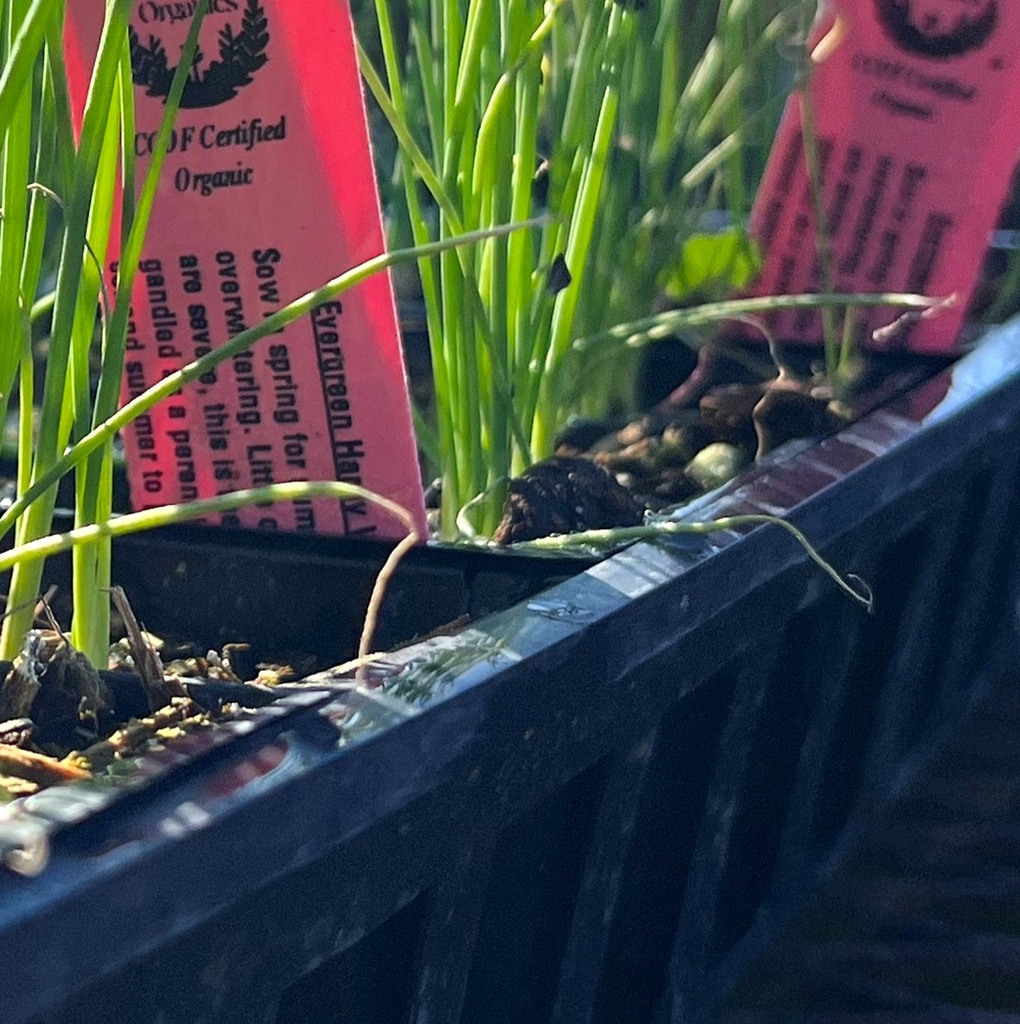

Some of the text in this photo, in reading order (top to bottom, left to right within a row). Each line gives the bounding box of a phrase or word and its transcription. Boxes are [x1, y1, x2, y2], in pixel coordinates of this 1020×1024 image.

[199, 115, 286, 151] Certified
[175, 161, 254, 197] Organic
[180, 256, 203, 294] are
[252, 248, 282, 304] Sow
[139, 259, 183, 358] gandled
[167, 406, 187, 419] a
[216, 250, 261, 435] overwitering.
[263, 345, 300, 423] spring
[315, 300, 353, 429] Evergreen
[337, 440, 368, 516] Hary
[126, 361, 158, 461] sumer
[142, 470, 164, 493] to
[203, 404, 230, 450] this
[283, 433, 308, 468] for
[211, 459, 234, 480] is
